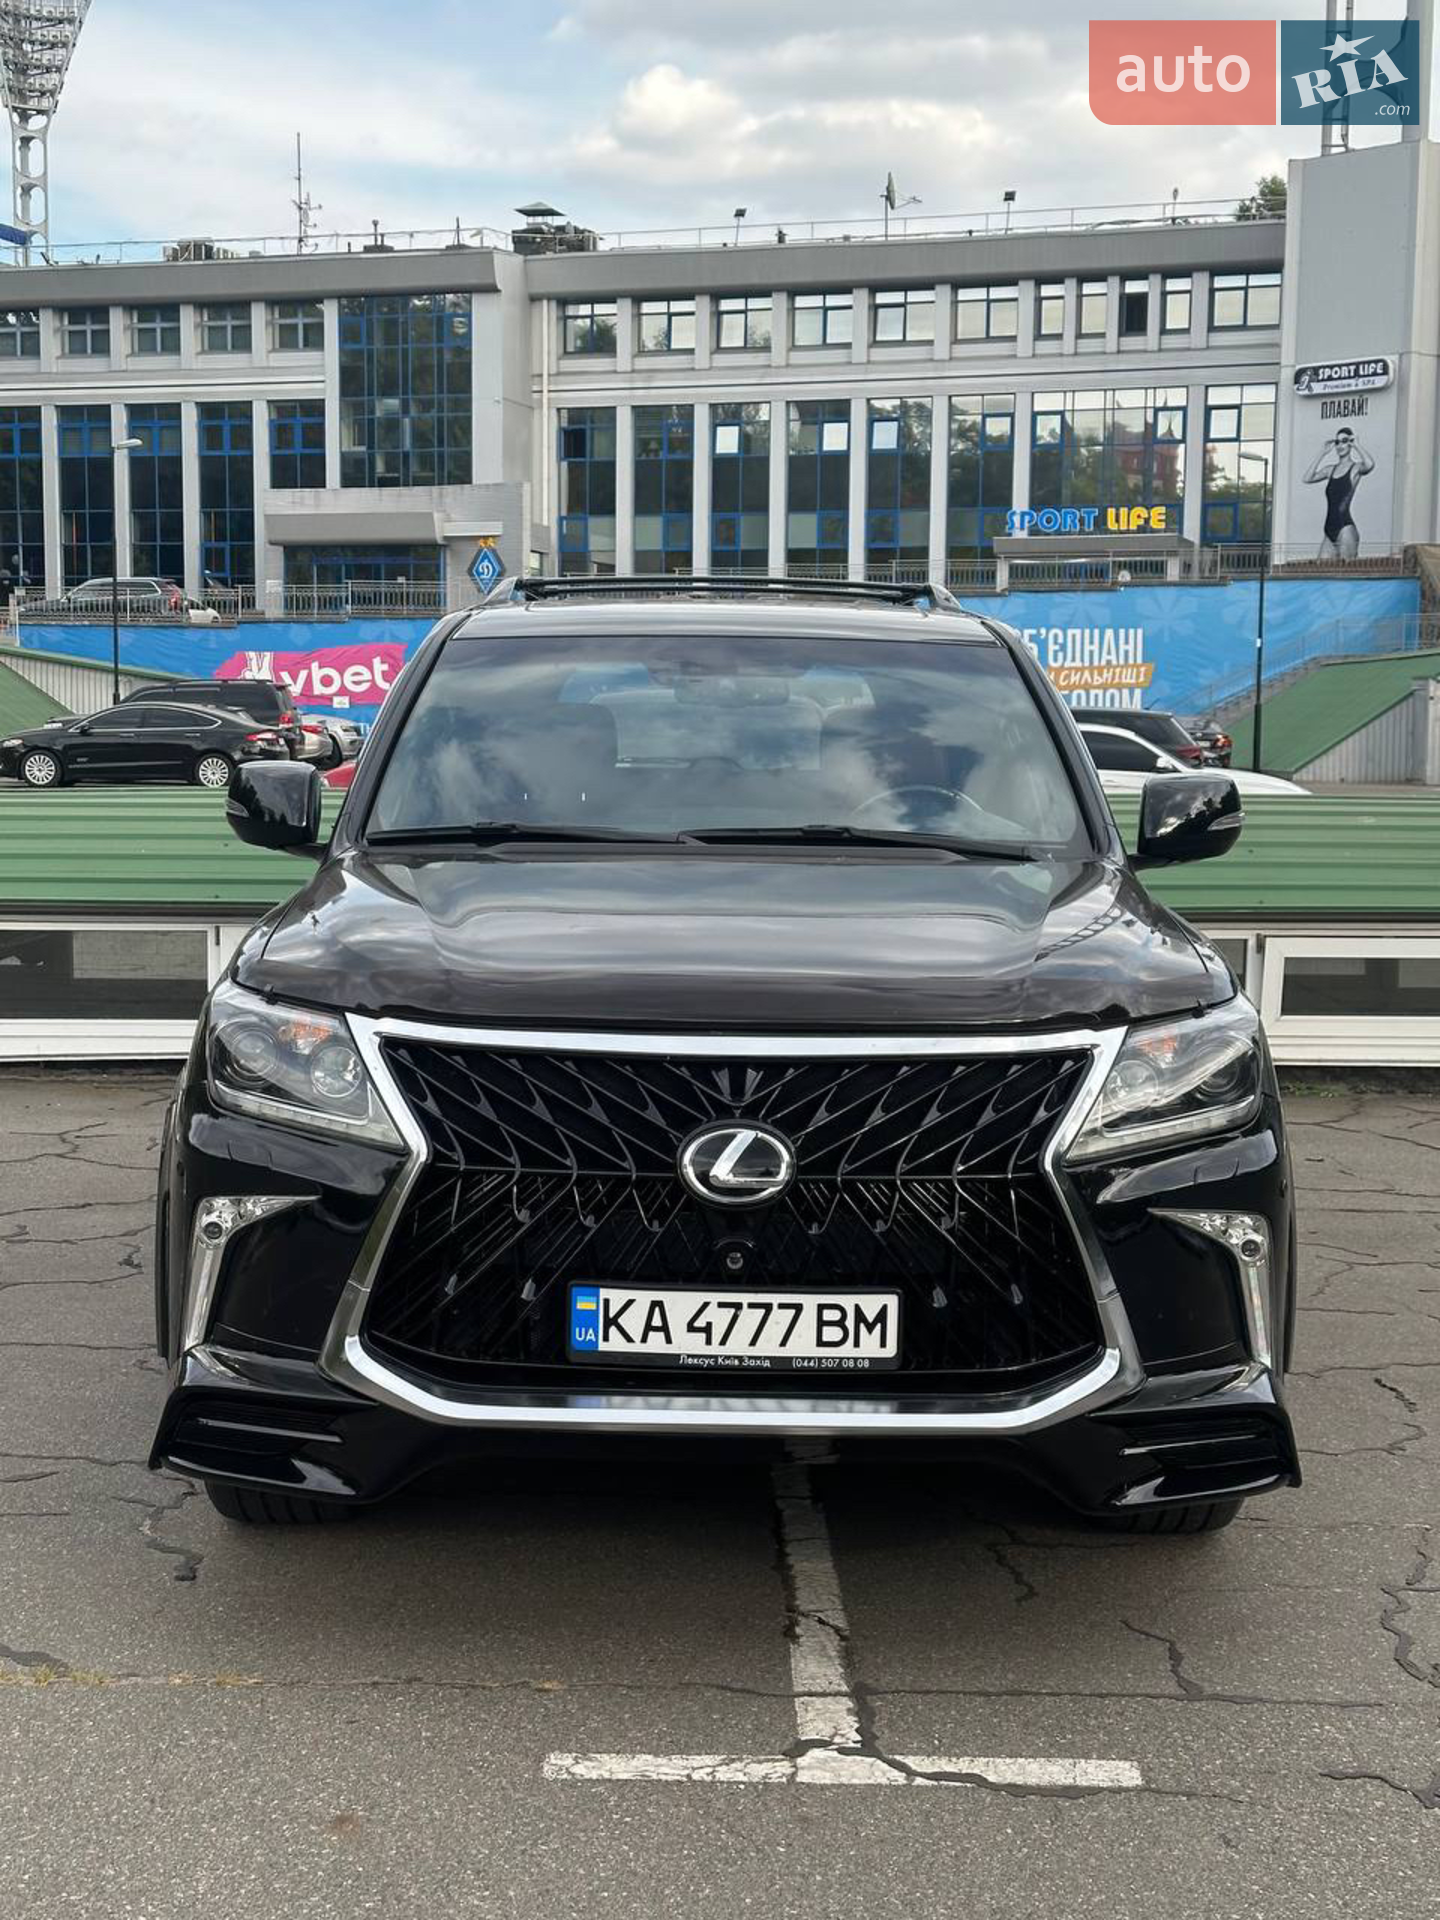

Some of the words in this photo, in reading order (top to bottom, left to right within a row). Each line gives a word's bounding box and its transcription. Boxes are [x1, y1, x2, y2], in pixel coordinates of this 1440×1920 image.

[1318, 365, 1356, 380] SPORT
[1359, 362, 1384, 375] LIFE
[1321, 395, 1369, 420] ПЛАВАЙ!
[1007, 508, 1098, 533] SPORT
[1106, 506, 1166, 530] LIFE
[279, 656, 391, 696] vbet
[576, 1327, 596, 1341] UA
[602, 1298, 673, 1344] KA
[686, 1301, 804, 1347] 4777
[816, 1303, 888, 1348] BM
[679, 1354, 715, 1367] Лексус
[717, 1355, 740, 1365] Київ
[742, 1356, 771, 1367] Захід
[792, 1358, 818, 1369] (044)
[821, 1358, 839, 1368] 507
[842, 1358, 855, 1368] 08
[857, 1358, 870, 1368] 08
